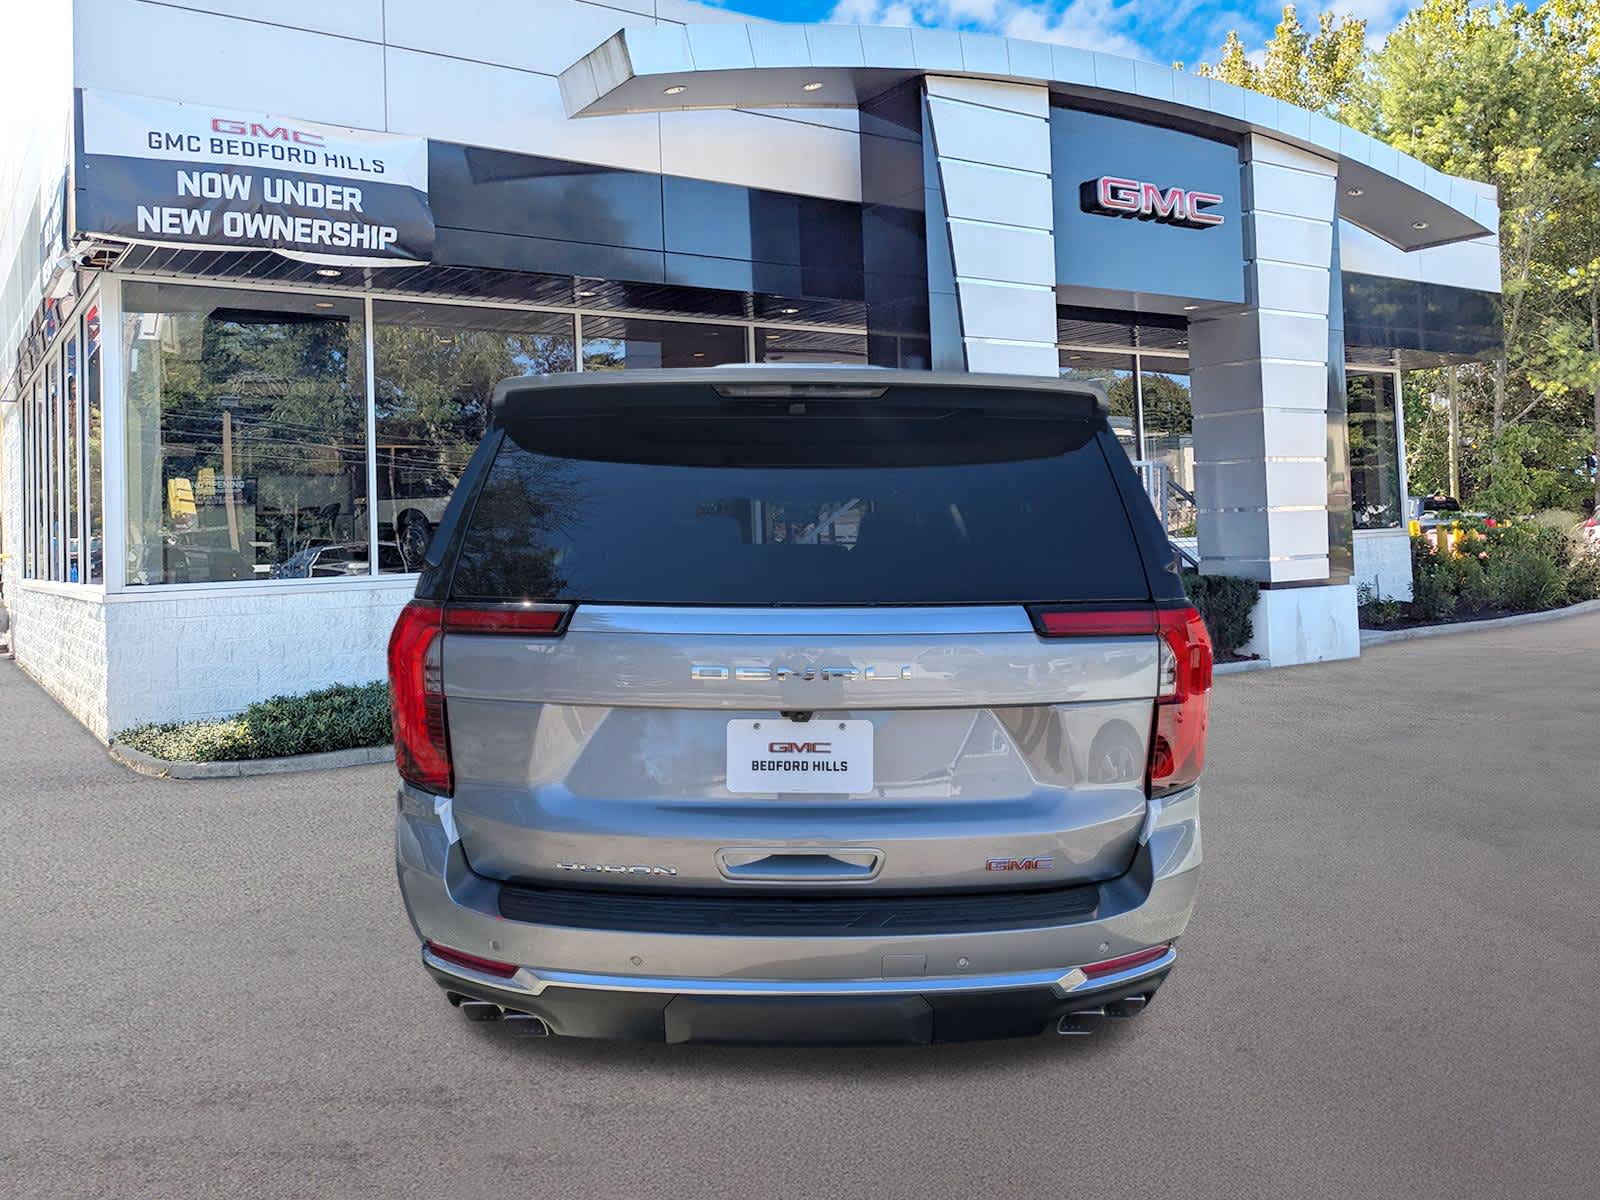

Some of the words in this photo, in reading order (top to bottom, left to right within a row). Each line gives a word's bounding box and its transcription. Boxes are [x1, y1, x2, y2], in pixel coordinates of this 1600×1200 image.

[211, 117, 326, 148] GMC
[148, 131, 201, 152] GMC
[210, 138, 317, 166] BEDFORD
[325, 153, 385, 174] HILLS
[176, 170, 252, 201] NOW
[263, 176, 364, 213] UNDER
[1098, 176, 1225, 225] GMC
[136, 205, 212, 236] NEW
[223, 210, 398, 250] OWNERSHIP
[691, 664, 912, 681] DENALI
[768, 742, 832, 754] GMC
[752, 760, 809, 772] BEDFORD
[813, 760, 848, 772] HILLS
[985, 856, 1054, 872] GMC
